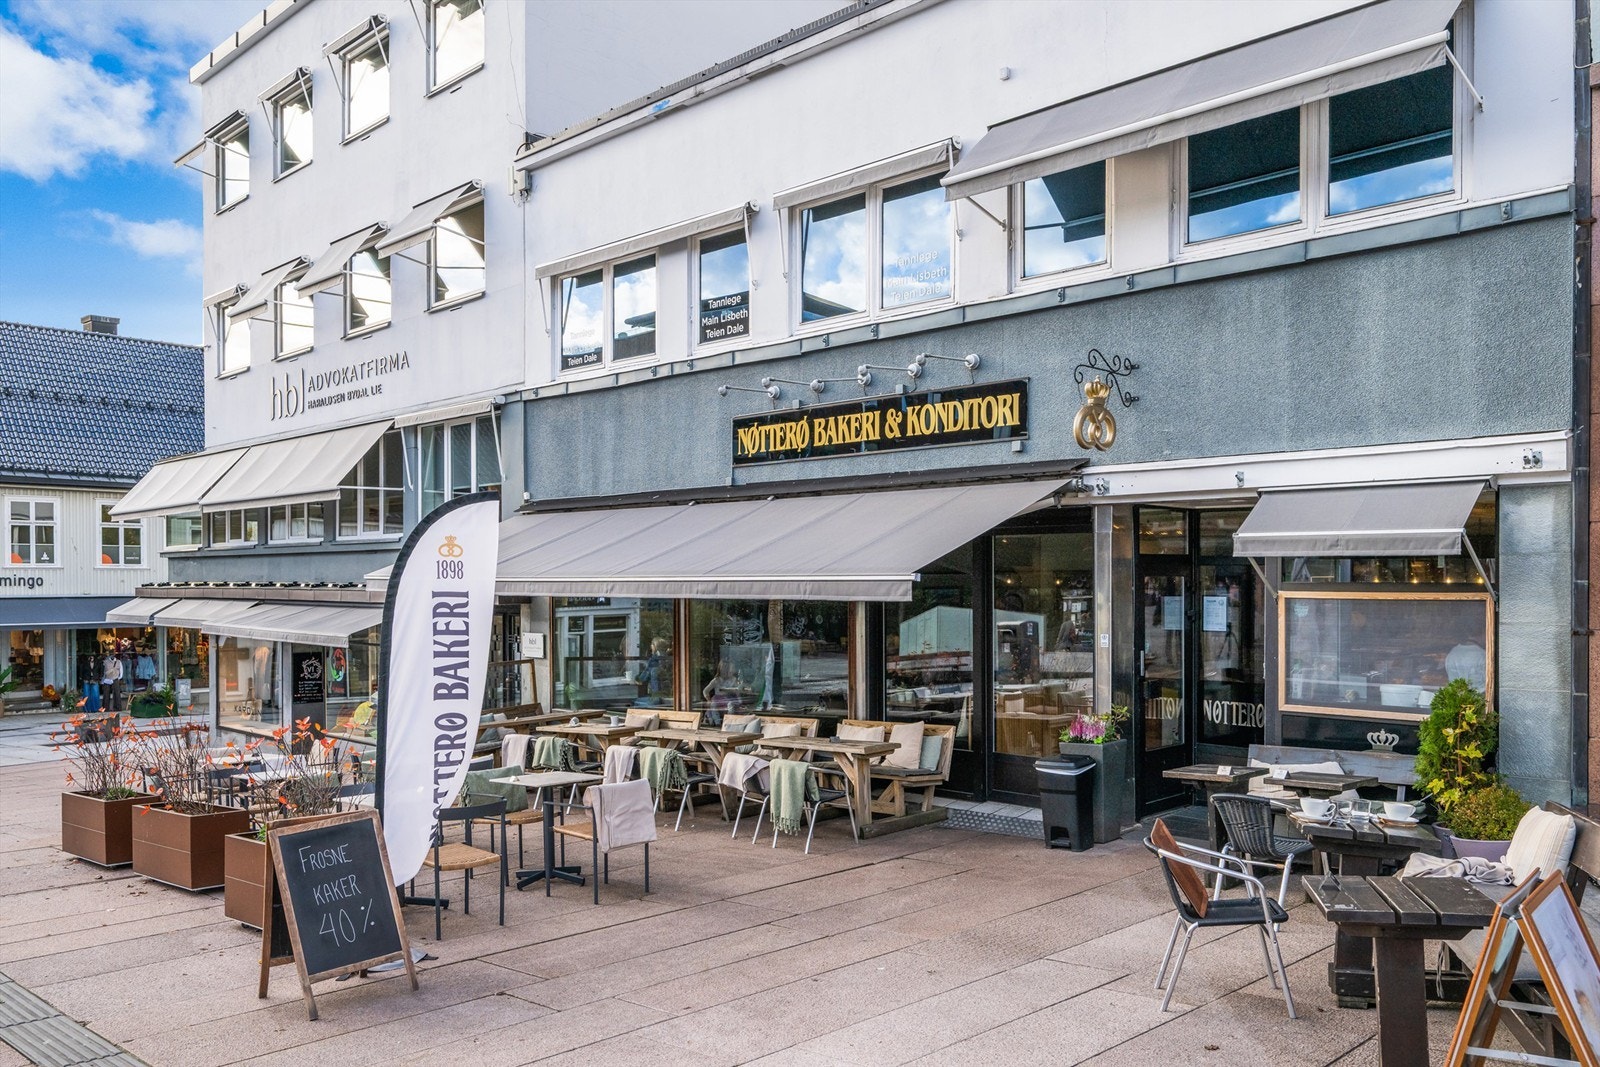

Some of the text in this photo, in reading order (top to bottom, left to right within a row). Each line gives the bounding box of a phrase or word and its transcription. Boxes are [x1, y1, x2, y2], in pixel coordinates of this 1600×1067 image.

[708, 295, 742, 309] Tannlege
[701, 308, 748, 327] Main Lisbeth
[705, 323, 744, 339] Teien Dale
[307, 350, 410, 393] ADVOKATFIRMA
[567, 353, 598, 367] Teien Dale
[271, 367, 305, 421] hbl
[307, 392, 346, 410] HARALDSEN
[370, 383, 383, 396] LIE
[737, 392, 1021, 458] NØTTERØ BAKERI & KONDITORI
[436, 560, 464, 580] 1898
[431, 590, 470, 701] BAKERI
[298, 843, 353, 873] FROSNE
[312, 874, 362, 906] KAKER
